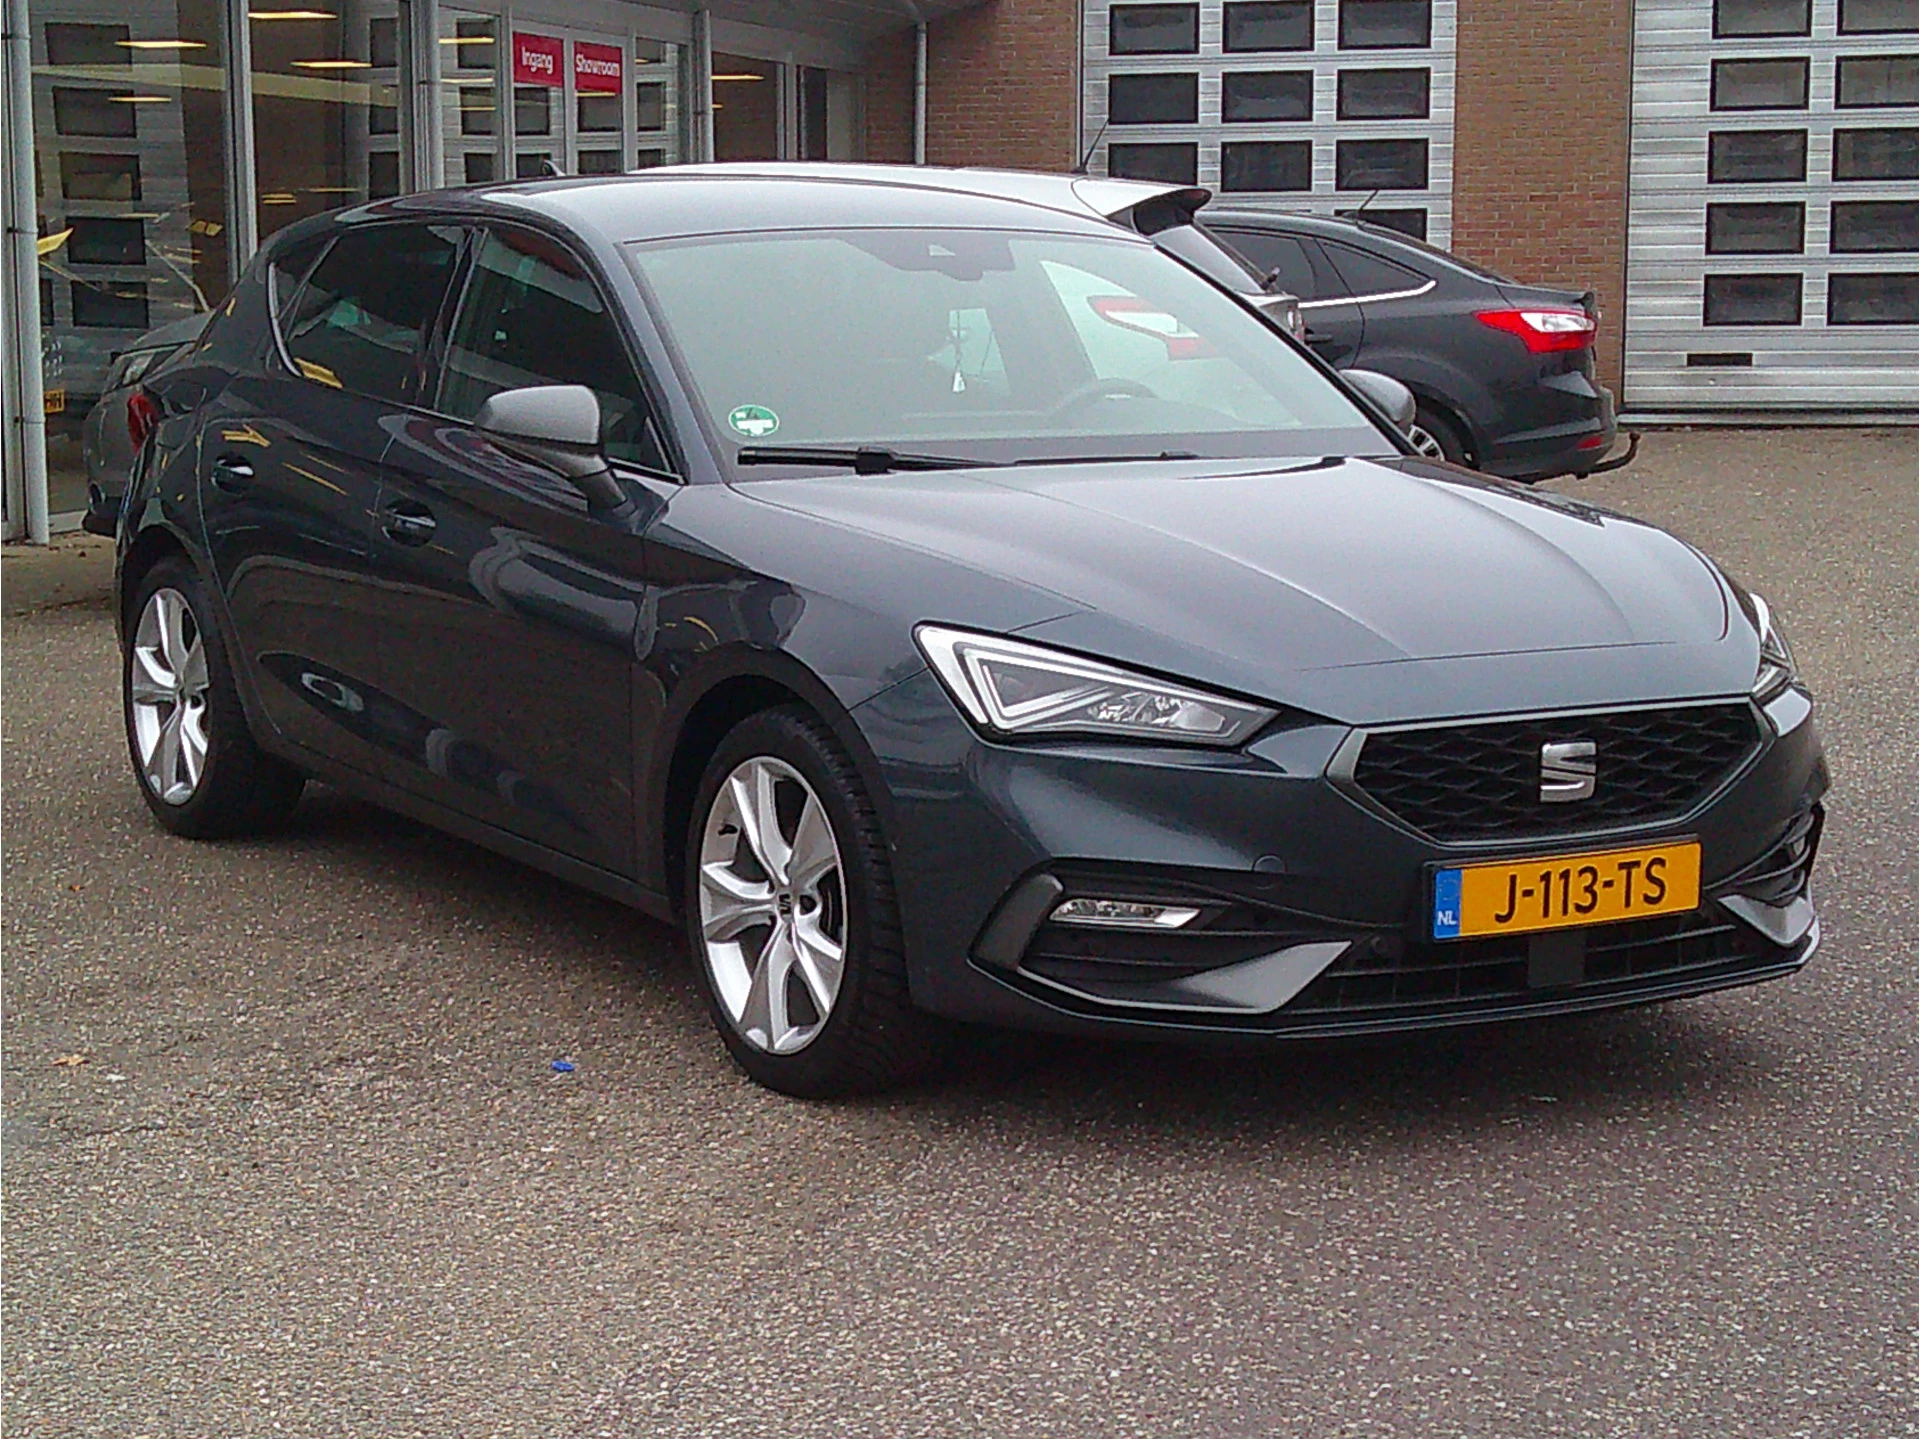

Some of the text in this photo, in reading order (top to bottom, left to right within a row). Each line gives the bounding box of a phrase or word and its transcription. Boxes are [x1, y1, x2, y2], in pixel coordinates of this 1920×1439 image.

[521, 46, 553, 75] Ingang
[576, 53, 620, 77] Showroom
[1494, 856, 1667, 924] J-113-TS
[1437, 910, 1457, 926] NL
